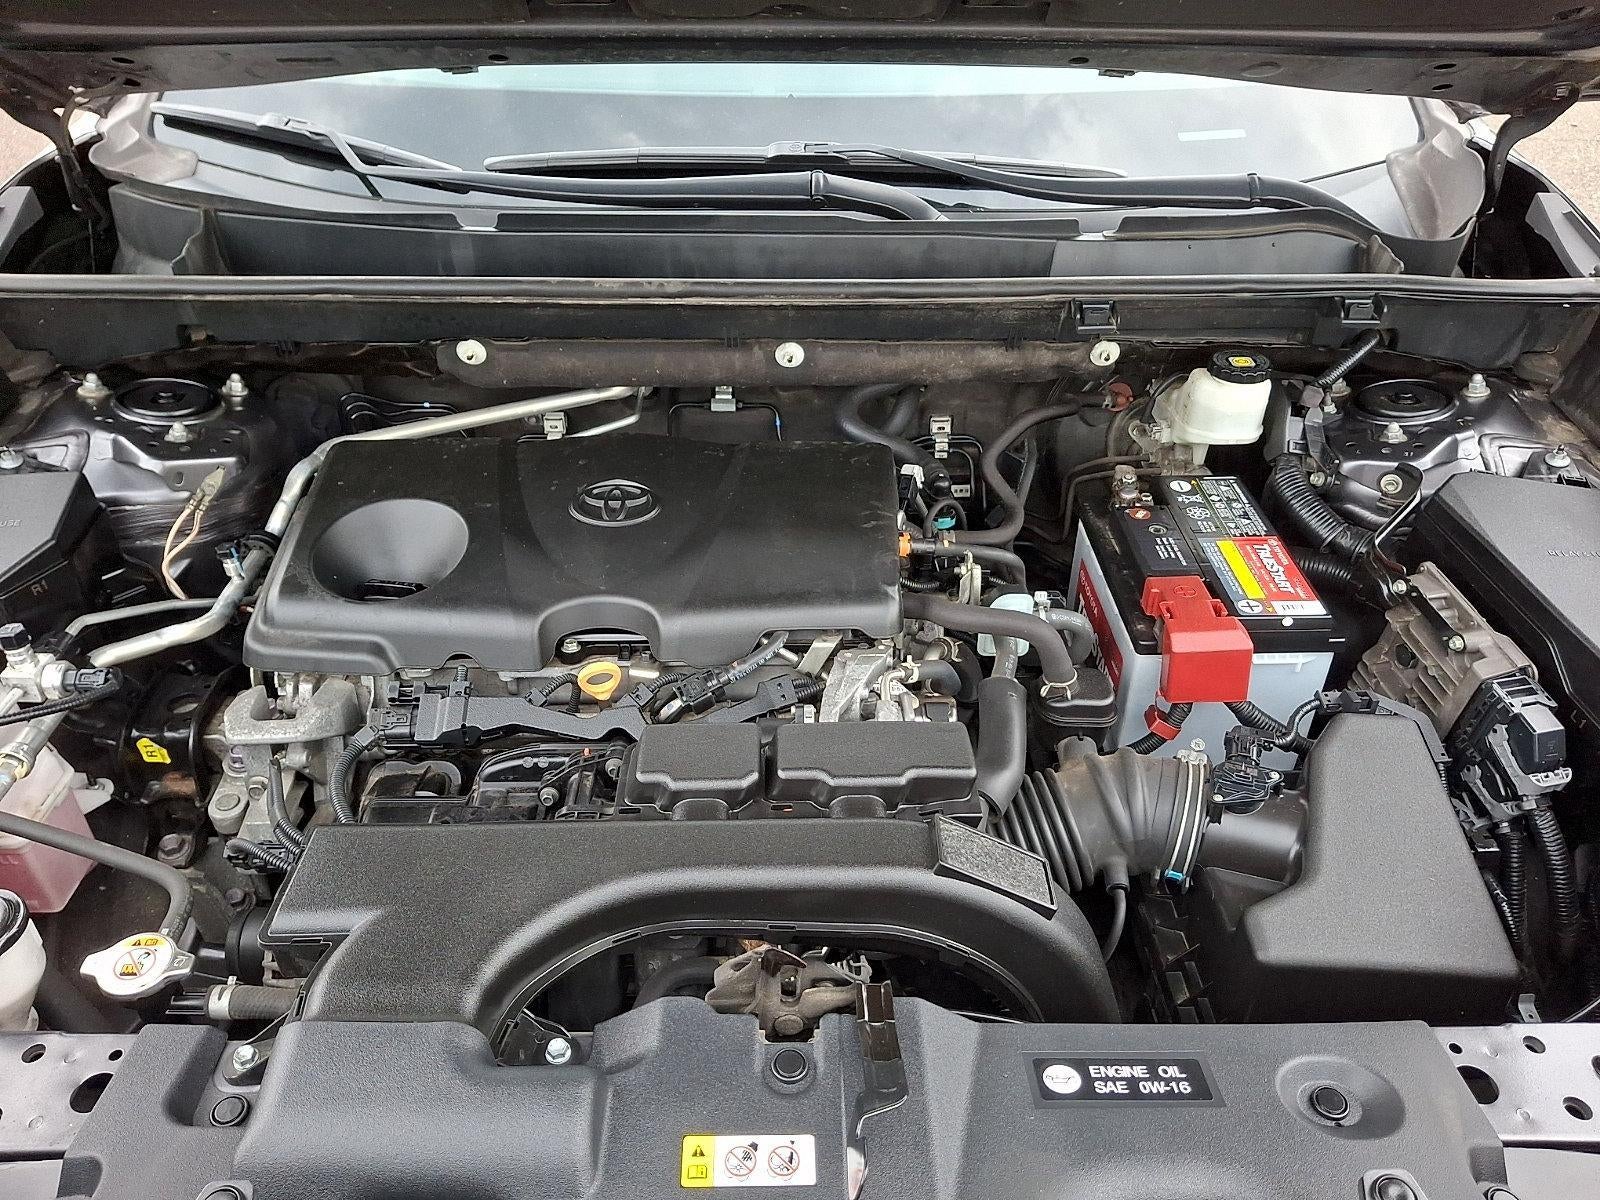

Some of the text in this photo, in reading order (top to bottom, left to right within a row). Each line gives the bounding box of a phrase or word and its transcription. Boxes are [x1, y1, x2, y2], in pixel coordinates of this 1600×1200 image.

[0, 519, 21, 528] USE
[143, 744, 158, 758] R1
[1088, 1065, 1188, 1078] ENGINE OIL
[1093, 1080, 1192, 1094] SAE 0W-16
